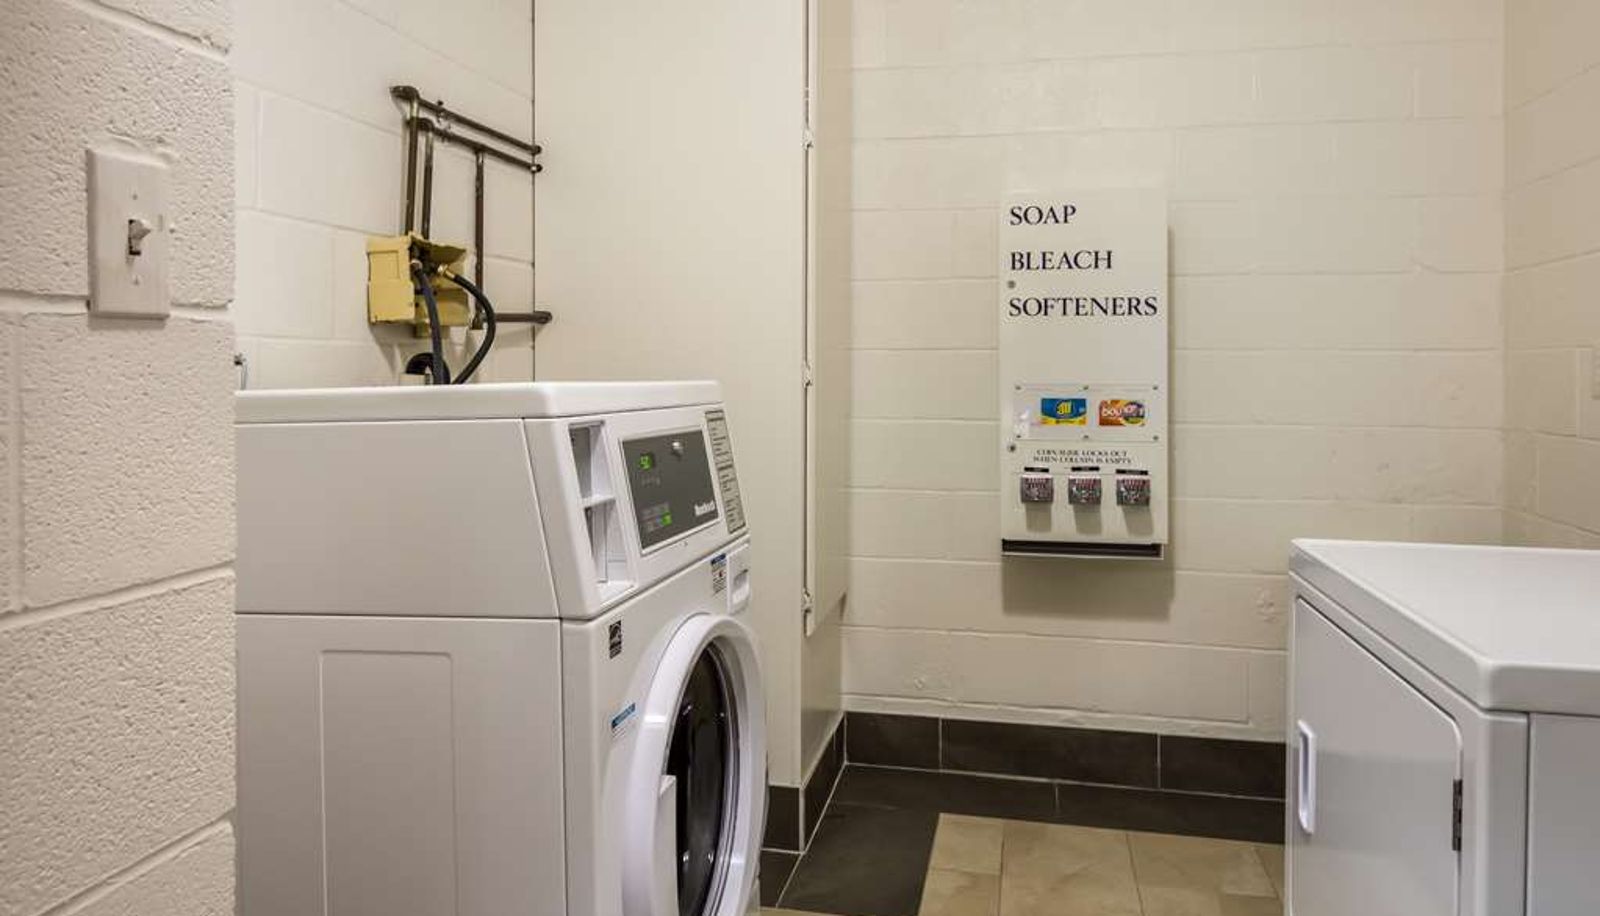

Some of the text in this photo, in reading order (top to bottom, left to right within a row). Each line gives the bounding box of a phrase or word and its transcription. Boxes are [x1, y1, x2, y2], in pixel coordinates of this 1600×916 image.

[1010, 205, 1077, 226] SOAP
[1010, 250, 1113, 271] BLEACH
[1008, 296, 1158, 317] SOFTENERS
